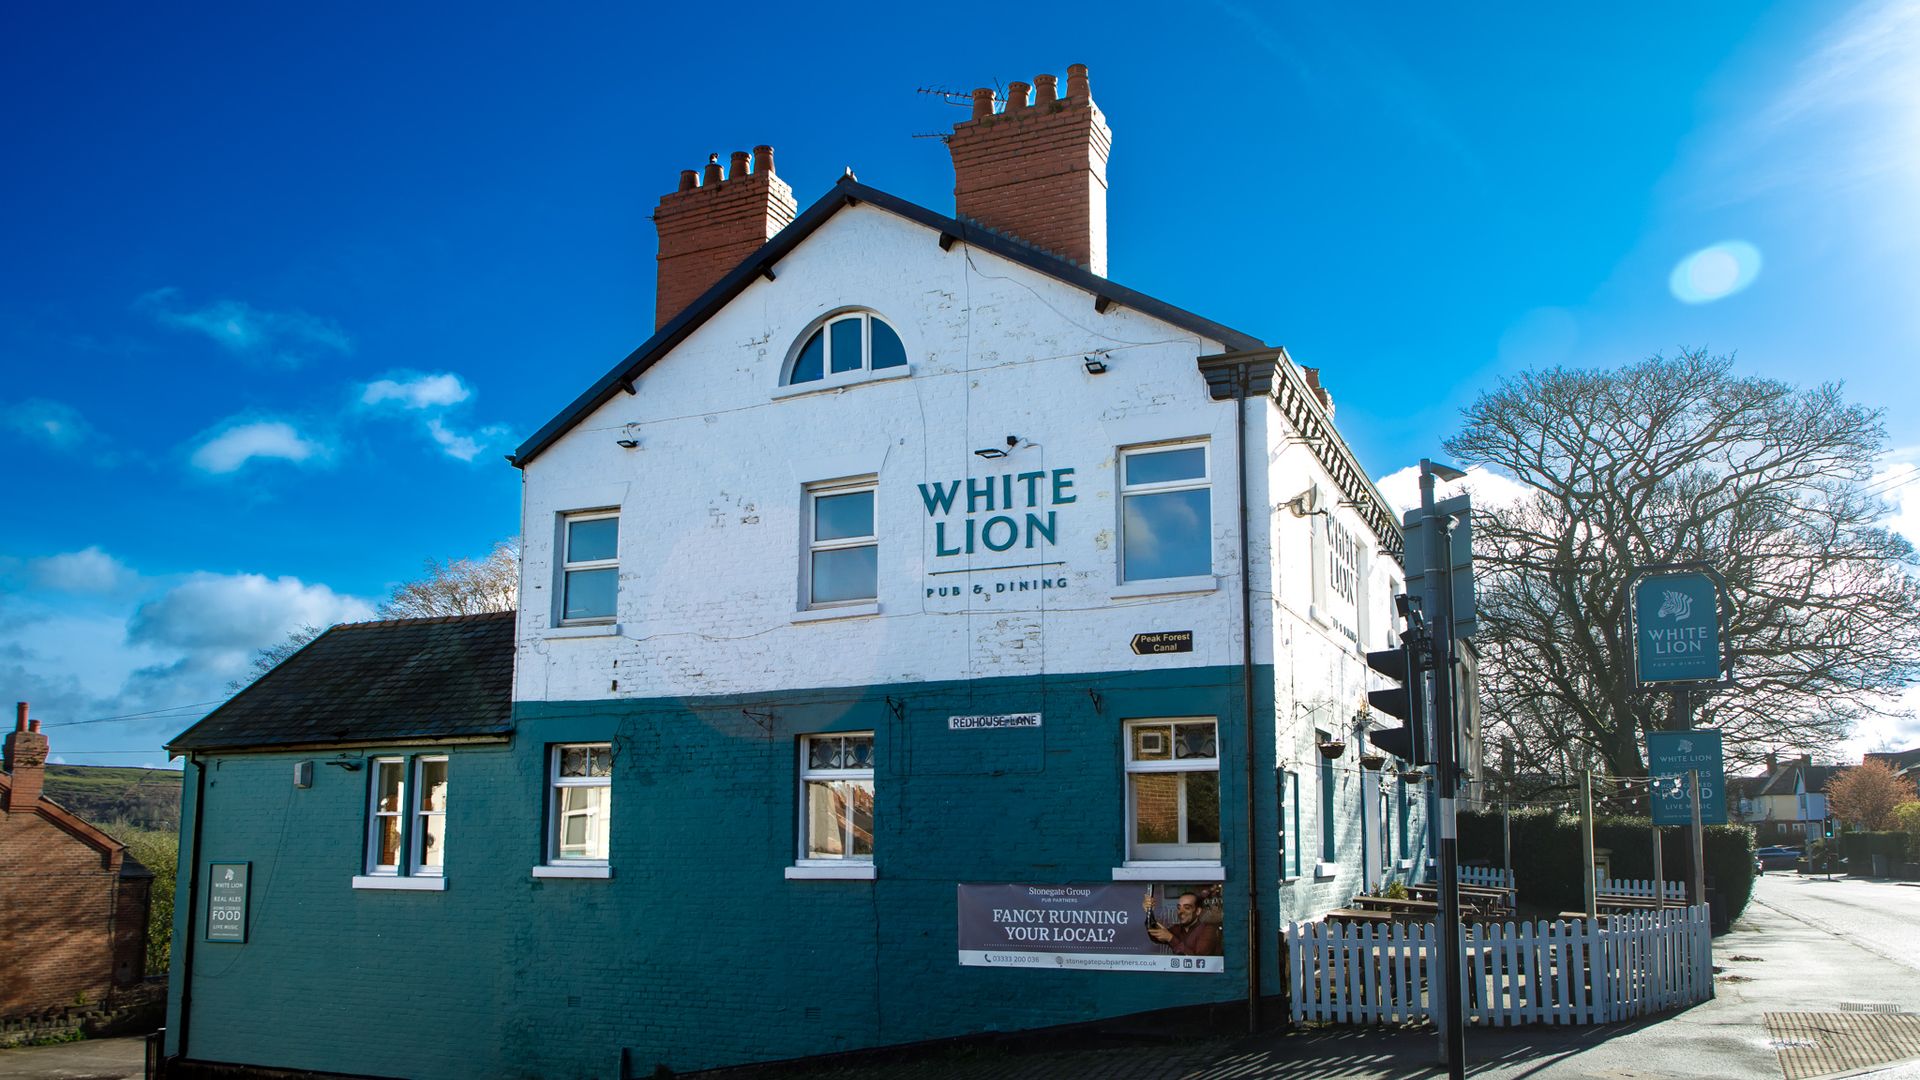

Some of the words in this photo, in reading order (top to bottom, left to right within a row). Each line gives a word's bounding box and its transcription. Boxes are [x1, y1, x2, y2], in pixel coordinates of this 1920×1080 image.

[917, 467, 1077, 517] WHITE
[935, 510, 1056, 557] LION
[926, 587, 961, 598] PUB
[972, 584, 982, 594] &
[995, 577, 1068, 593] DINING
[1140, 634, 1161, 643] Peak
[1163, 633, 1190, 642] Forest
[1648, 626, 1708, 641] WHITE
[1153, 643, 1178, 652] Canal
[1655, 640, 1701, 654] LION
[1028, 887, 1065, 897] Stonegate
[1066, 887, 1091, 897] Group
[212, 910, 241, 921] FOOD
[992, 909, 1046, 924] FANCY
[1048, 910, 1129, 924] RUNNING
[1005, 926, 1050, 941] YOUR
[1053, 927, 1116, 942] LOCAL?
[1065, 957, 1157, 967] stonegatepubpartners.co.uk
